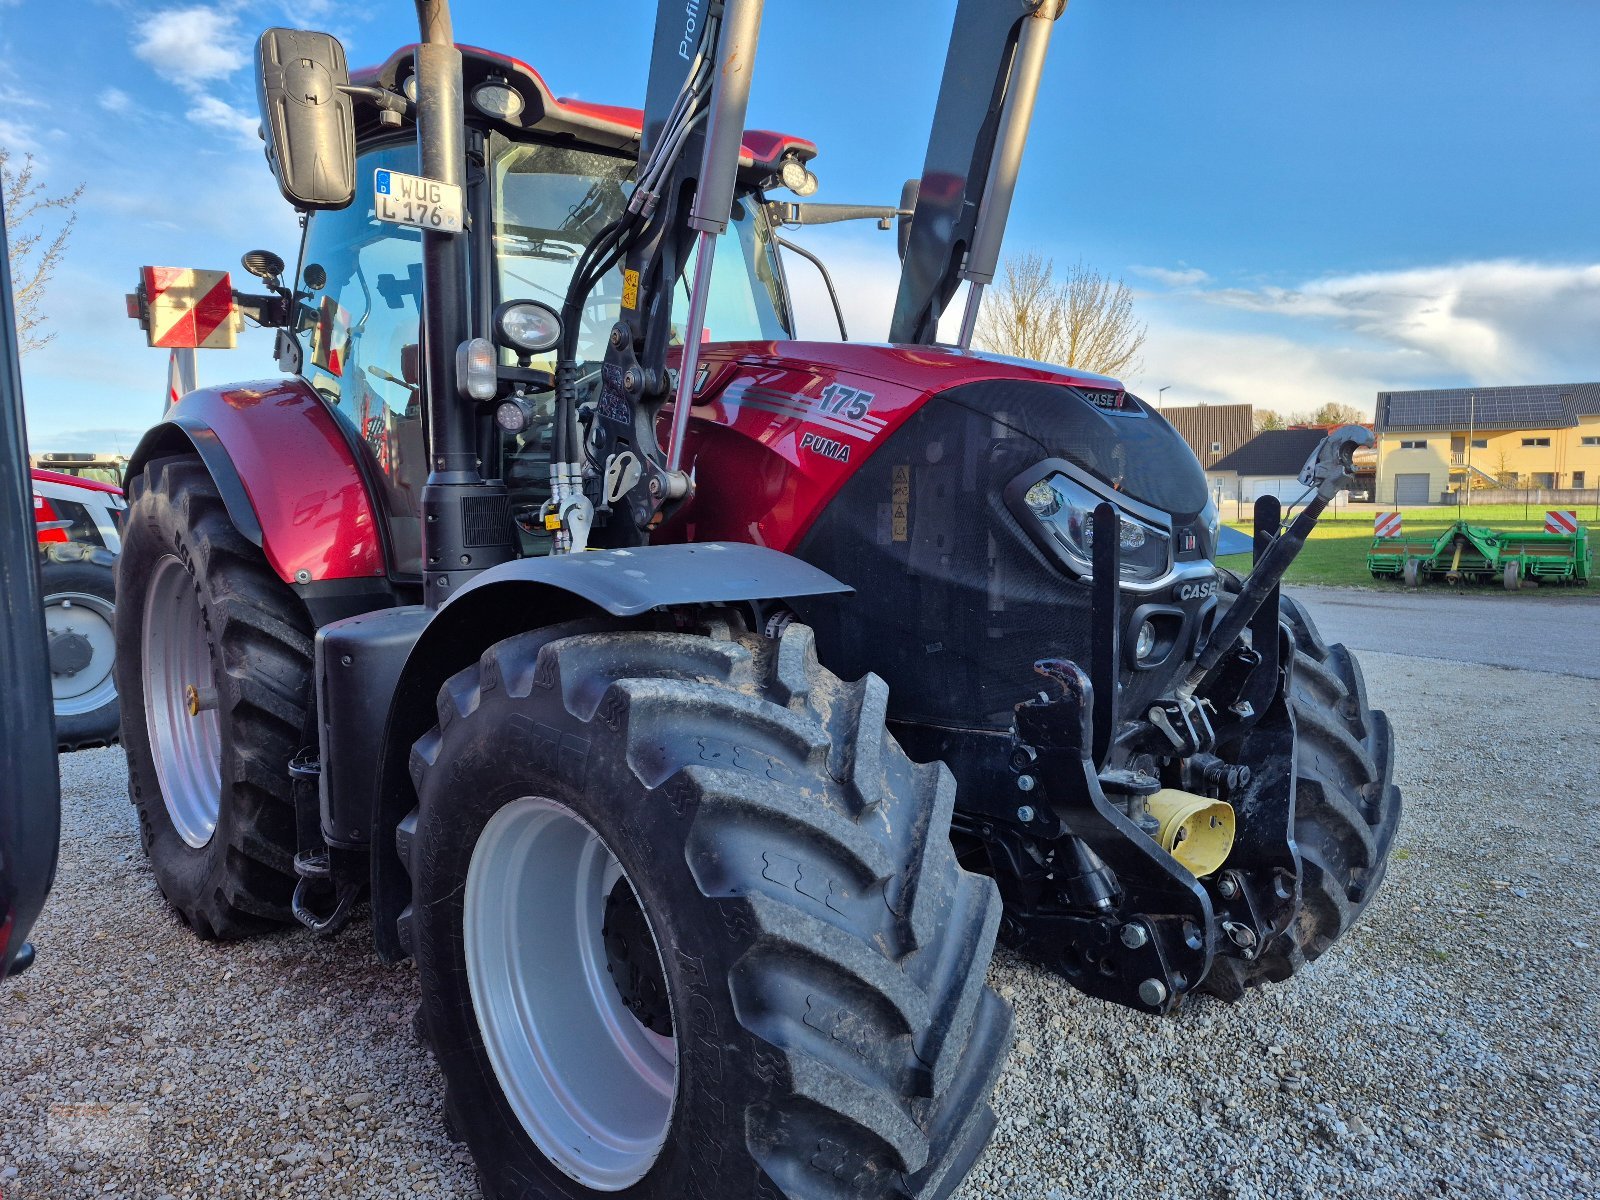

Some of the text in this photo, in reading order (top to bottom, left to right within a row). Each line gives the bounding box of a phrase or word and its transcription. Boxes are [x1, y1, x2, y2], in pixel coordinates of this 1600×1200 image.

[400, 178, 441, 204] WUG
[382, 197, 442, 226] L 176
[819, 383, 875, 421] 175
[1087, 393, 1114, 407] CASE
[800, 432, 850, 462] PUMA
[1180, 581, 1217, 601] CASE
